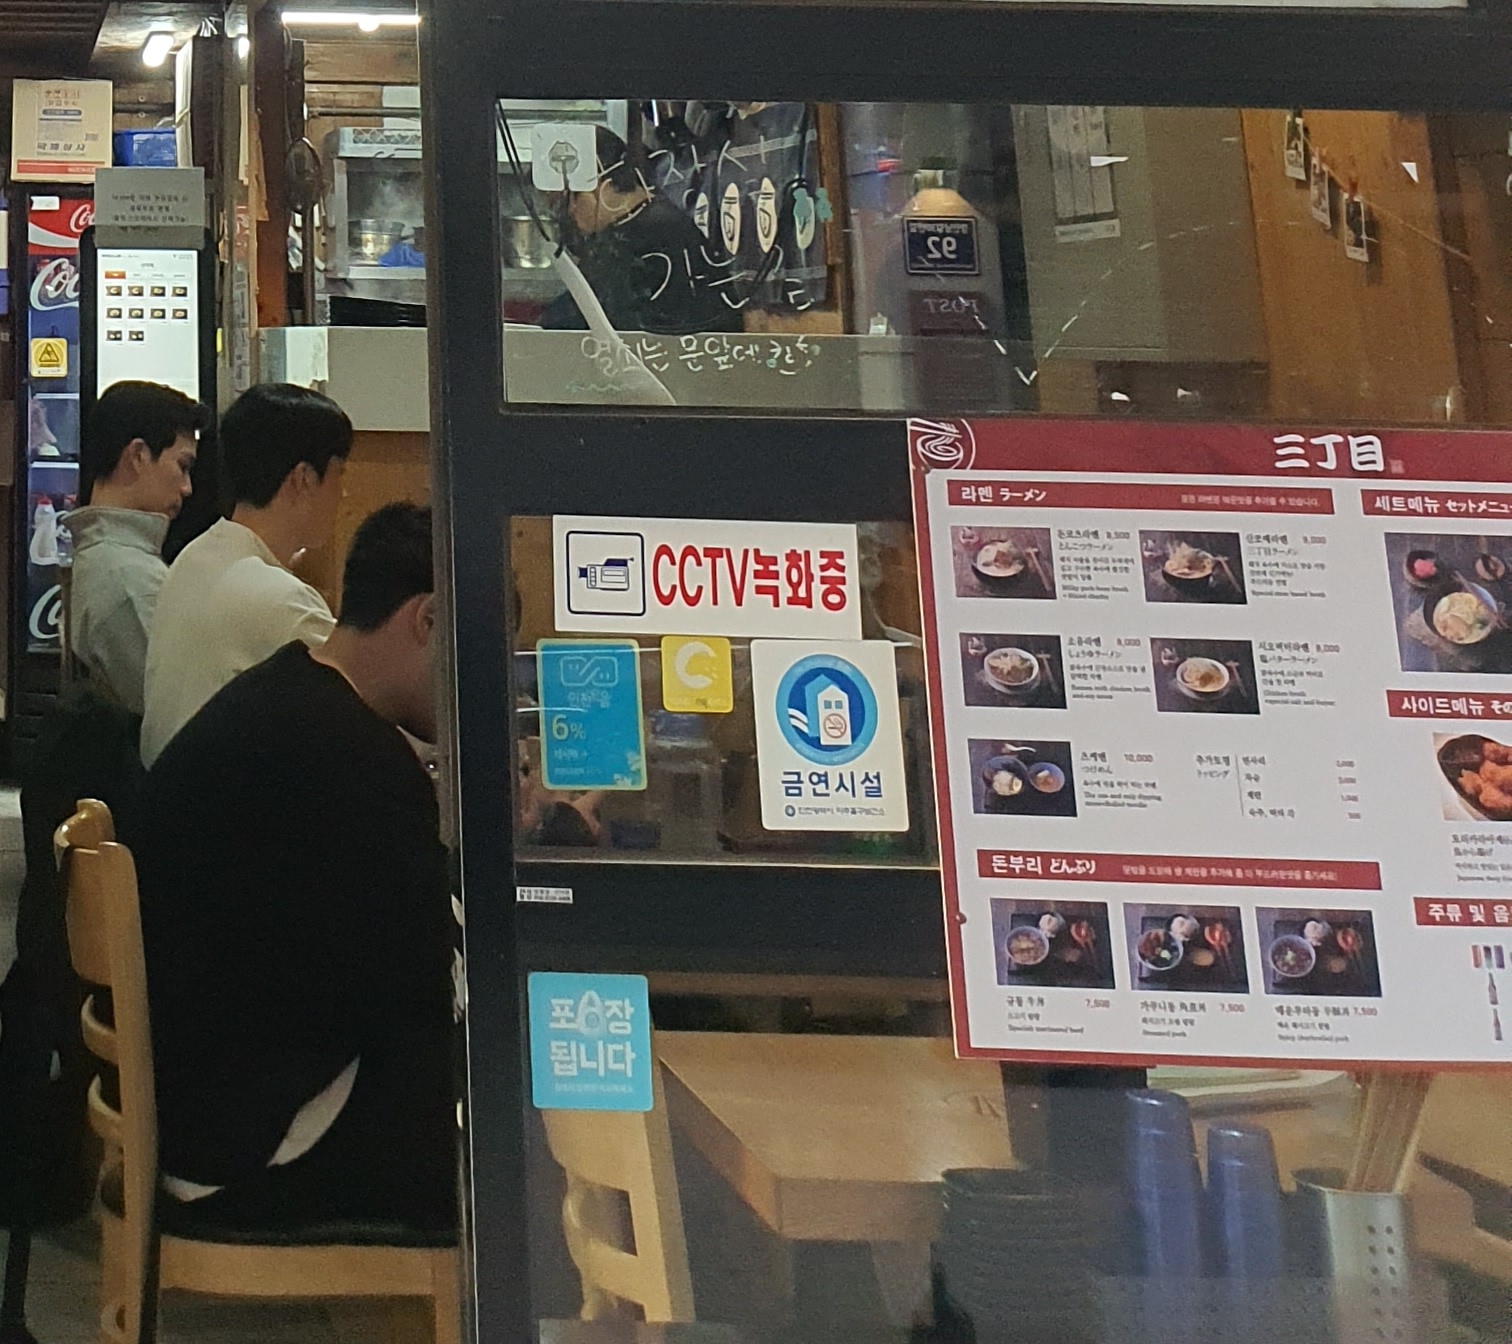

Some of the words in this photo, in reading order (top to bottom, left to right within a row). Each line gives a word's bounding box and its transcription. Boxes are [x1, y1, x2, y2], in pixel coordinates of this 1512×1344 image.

[1272, 433, 1386, 473] 三丁目
[960, 486, 994, 502] 라멘
[999, 487, 1048, 502] ラーメン
[1374, 495, 1441, 514] 세트메뉴
[1445, 498, 1512, 513] セットメニュ
[652, 543, 848, 612] CCTV녹화중
[1401, 696, 1486, 715] 사이드메뉴
[781, 770, 883, 799] 금연시설
[990, 855, 1043, 875] 돈부리
[1049, 858, 1097, 876] どんぶり
[1428, 903, 1463, 922] 주류
[549, 997, 635, 1035] 포장
[549, 1039, 636, 1078] 됩니다
